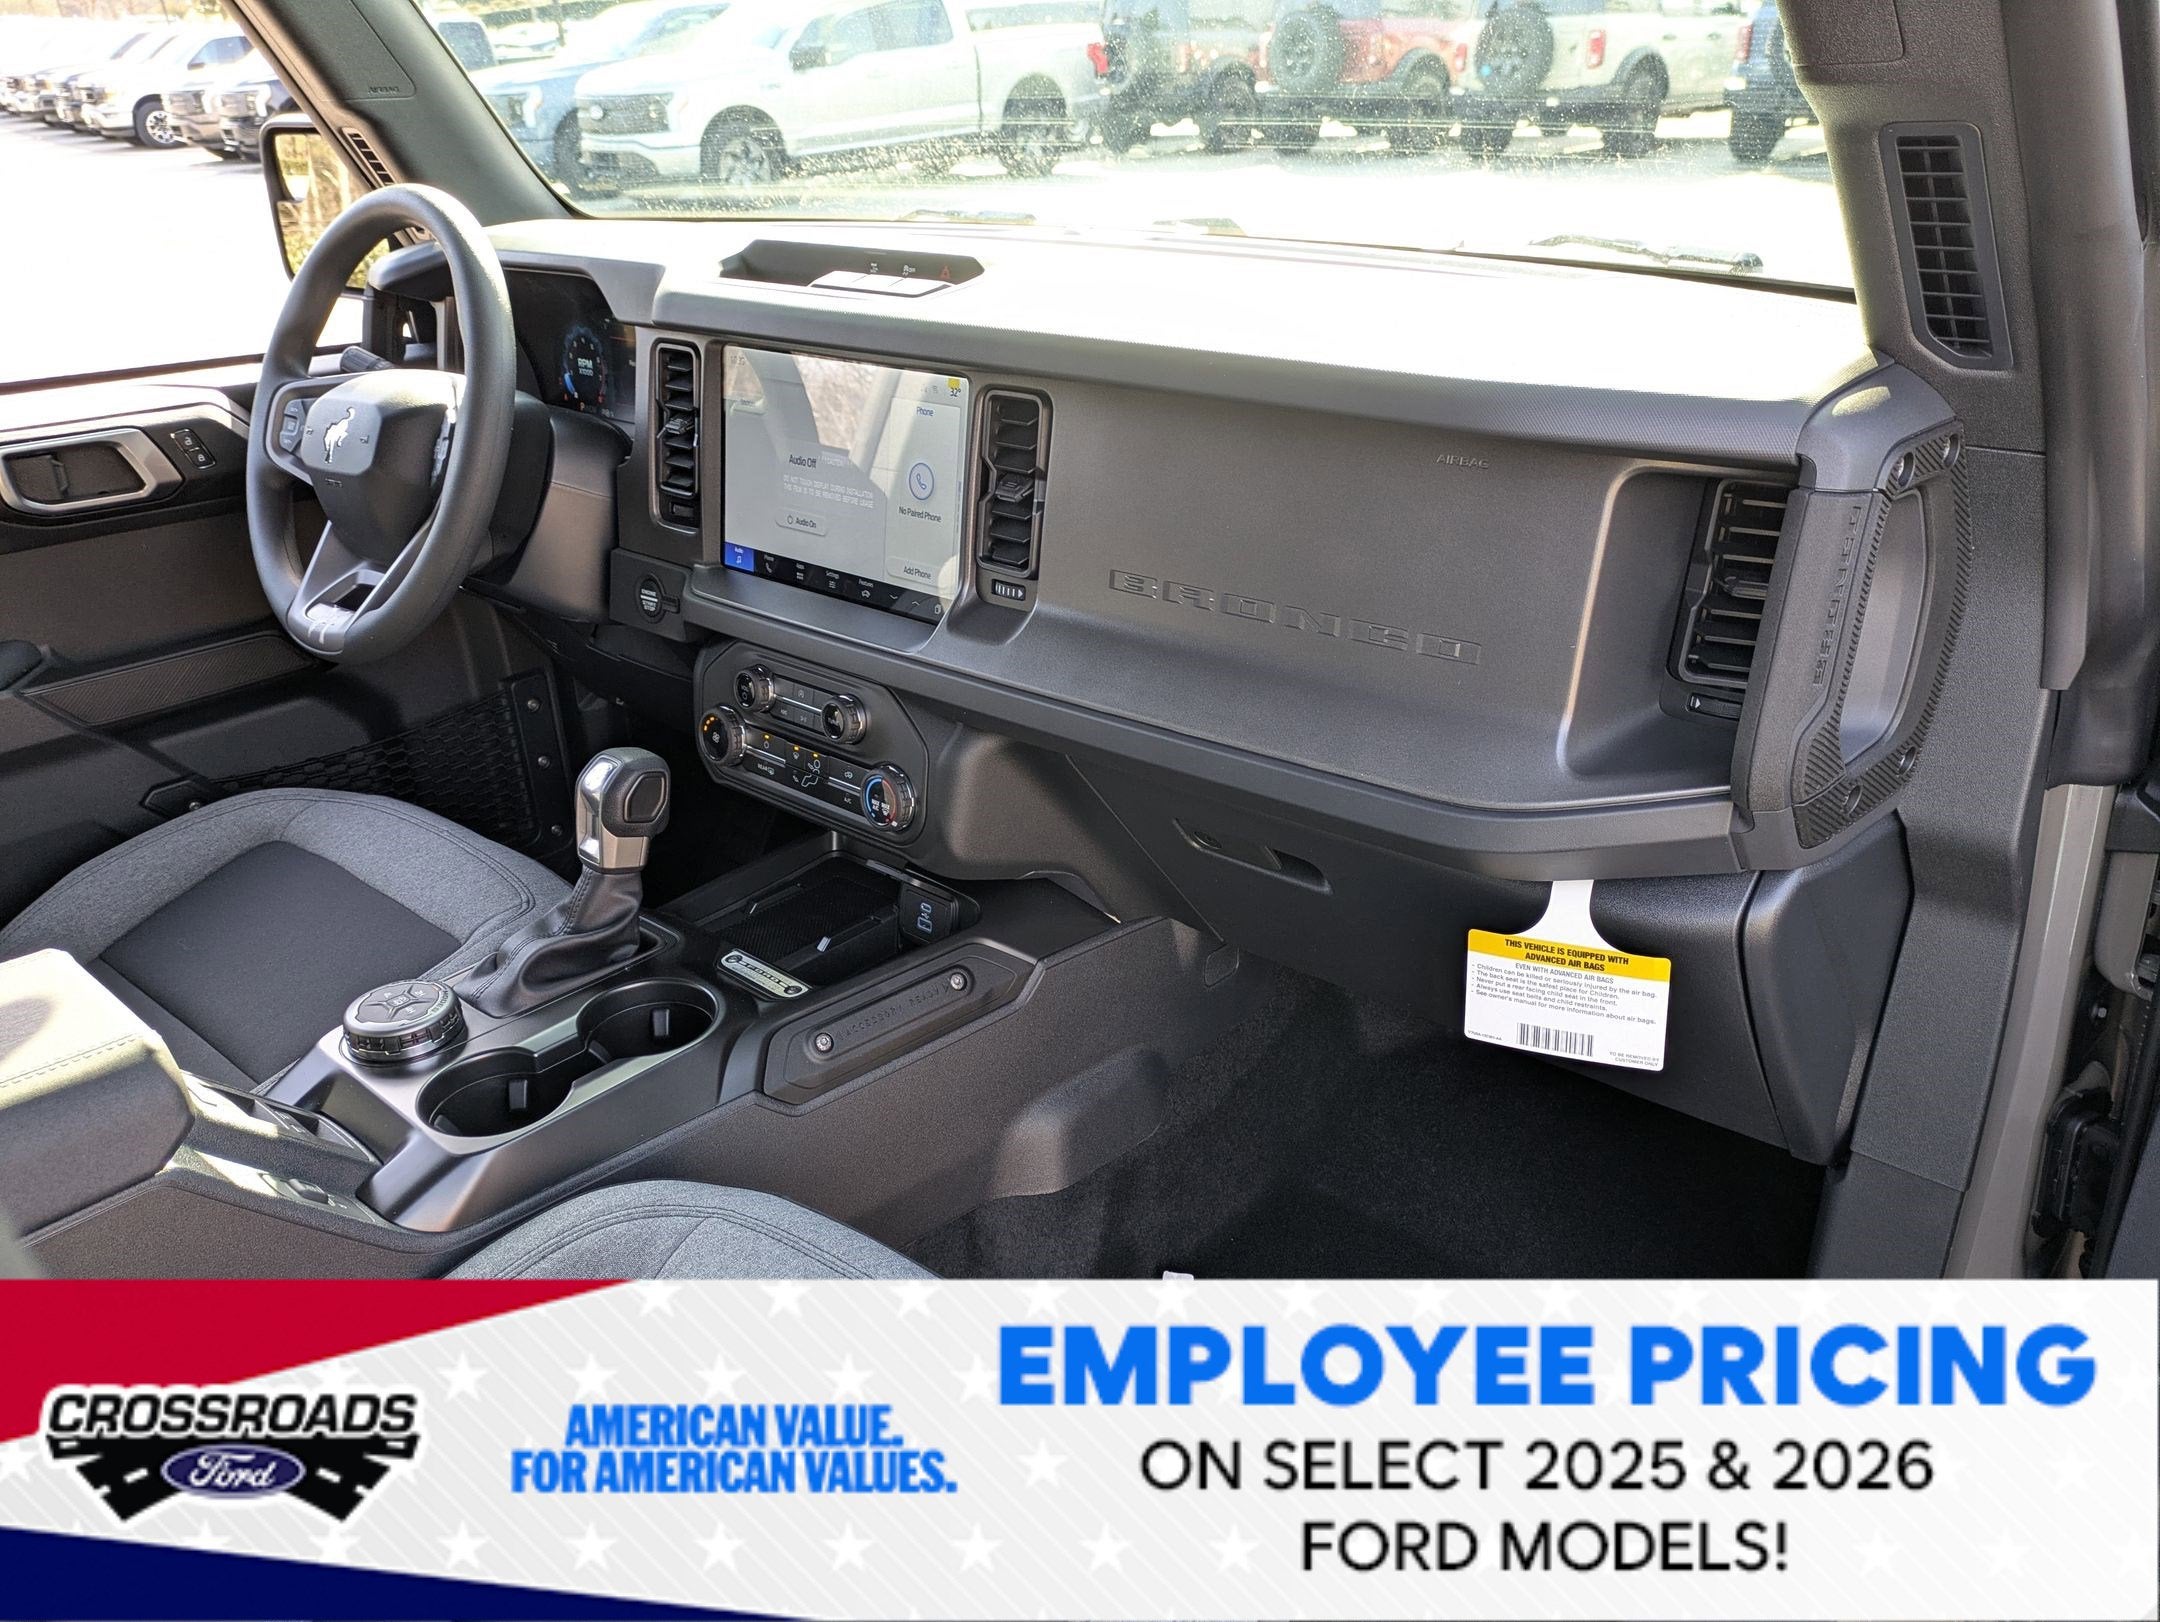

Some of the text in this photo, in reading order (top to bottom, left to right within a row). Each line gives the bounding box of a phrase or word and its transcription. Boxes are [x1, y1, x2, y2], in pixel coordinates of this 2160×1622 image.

[916, 405, 933, 417] Phone
[788, 453, 816, 469] Audio Off
[1436, 454, 1489, 469] AIRBAG
[898, 505, 941, 523] No Paired Phone
[903, 565, 931, 580] Add Phone
[1109, 569, 1482, 665] BRONCO
[1504, 938, 1628, 965] THIS VEHICLE IS EQUIPPED WITH
[1524, 952, 1605, 972] ADVANCED AIR BAGS
[1476, 962, 1502, 973] Children
[1525, 972, 1543, 980] killed
[1552, 977, 1582, 988] seriously
[1584, 981, 1607, 992] injured
[1608, 985, 1617, 993] by
[1618, 986, 1630, 994] the
[1489, 972, 1503, 980] back
[1505, 975, 1518, 983] seat
[1538, 981, 1558, 989] safest
[1559, 985, 1577, 993] place
[1515, 962, 1614, 984] EVEN WITH ADVANCED AIR BAGS
[1476, 976, 1494, 984] Never
[1525, 985, 1545, 995] facing
[1546, 989, 1562, 997] child
[1564, 992, 1578, 1000] seat
[1476, 982, 1497, 992] Always
[1526, 992, 1541, 1000] belts
[1543, 995, 1555, 1003] and
[1556, 997, 1573, 1006] child
[1487, 991, 1512, 1002] owner's
[1513, 996, 1537, 1006] manual
[1537, 1000, 1547, 1008] for
[1548, 1003, 1565, 1011] more
[1566, 1005, 1604, 1018] information
[1605, 1012, 1626, 1021] about
